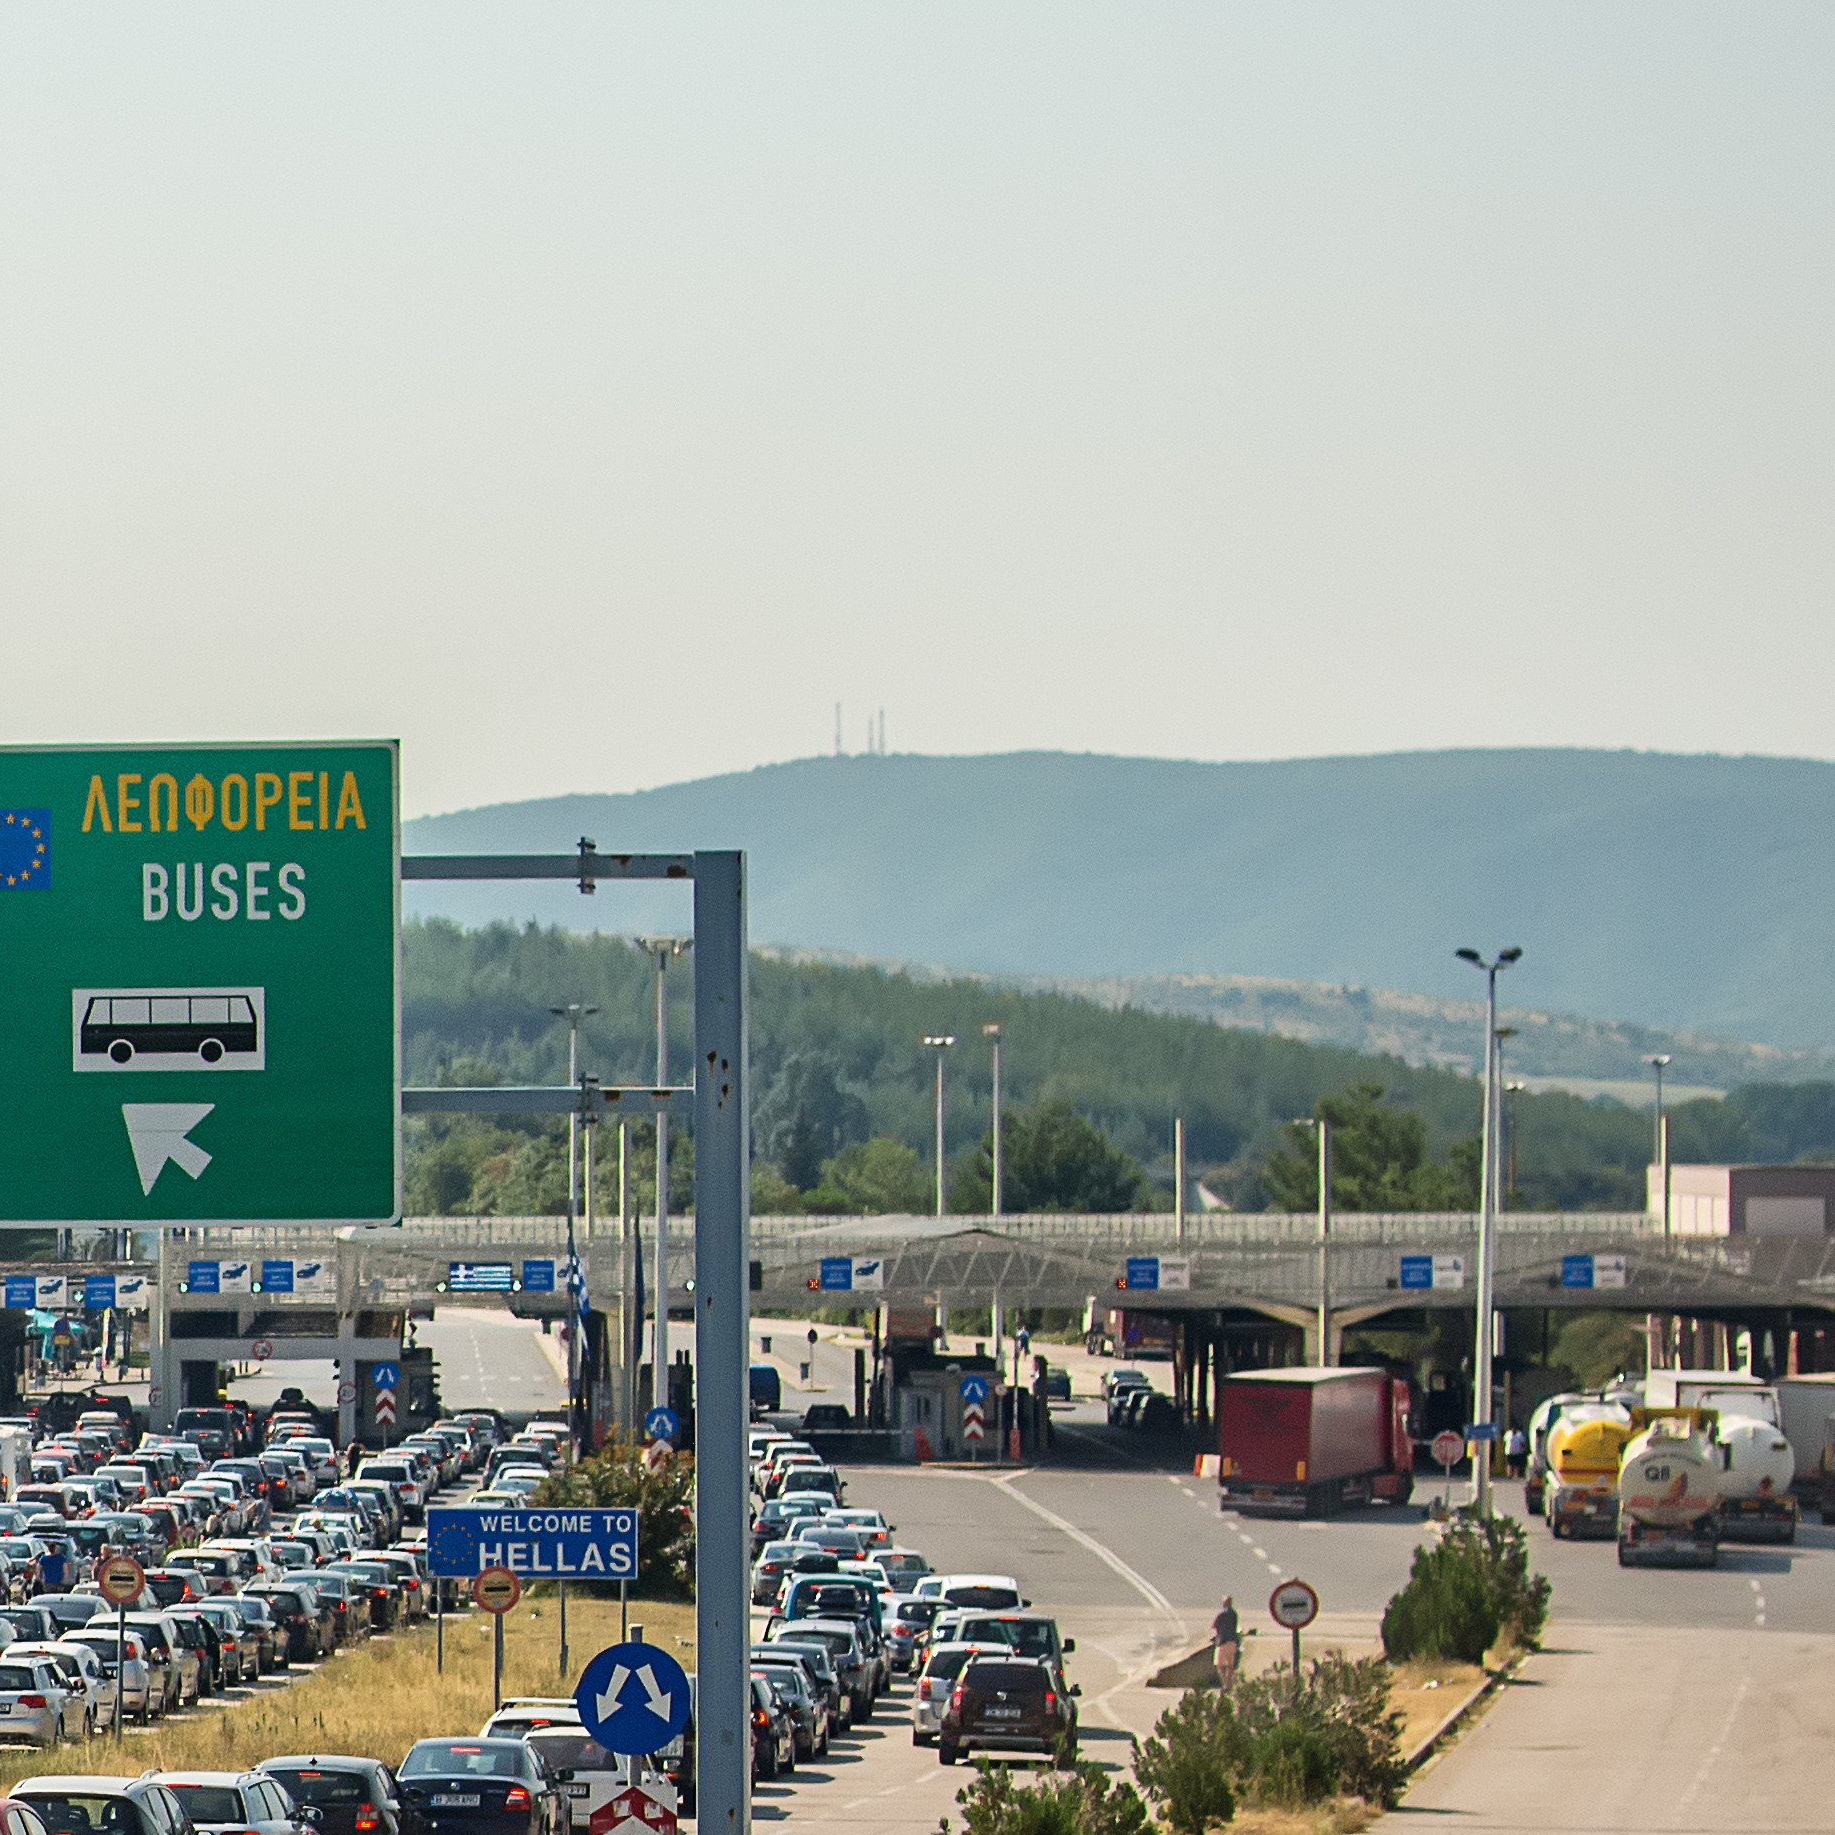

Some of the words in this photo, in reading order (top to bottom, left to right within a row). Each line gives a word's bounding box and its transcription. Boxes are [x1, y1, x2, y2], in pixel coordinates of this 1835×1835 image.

[81, 771, 366, 833] ΛΕΩΦΟΡΕΙΑ
[142, 861, 306, 921] BUSES
[479, 1515, 592, 1533] WELCOME
[603, 1515, 631, 1533] TO
[479, 1542, 631, 1572] HELLAS
